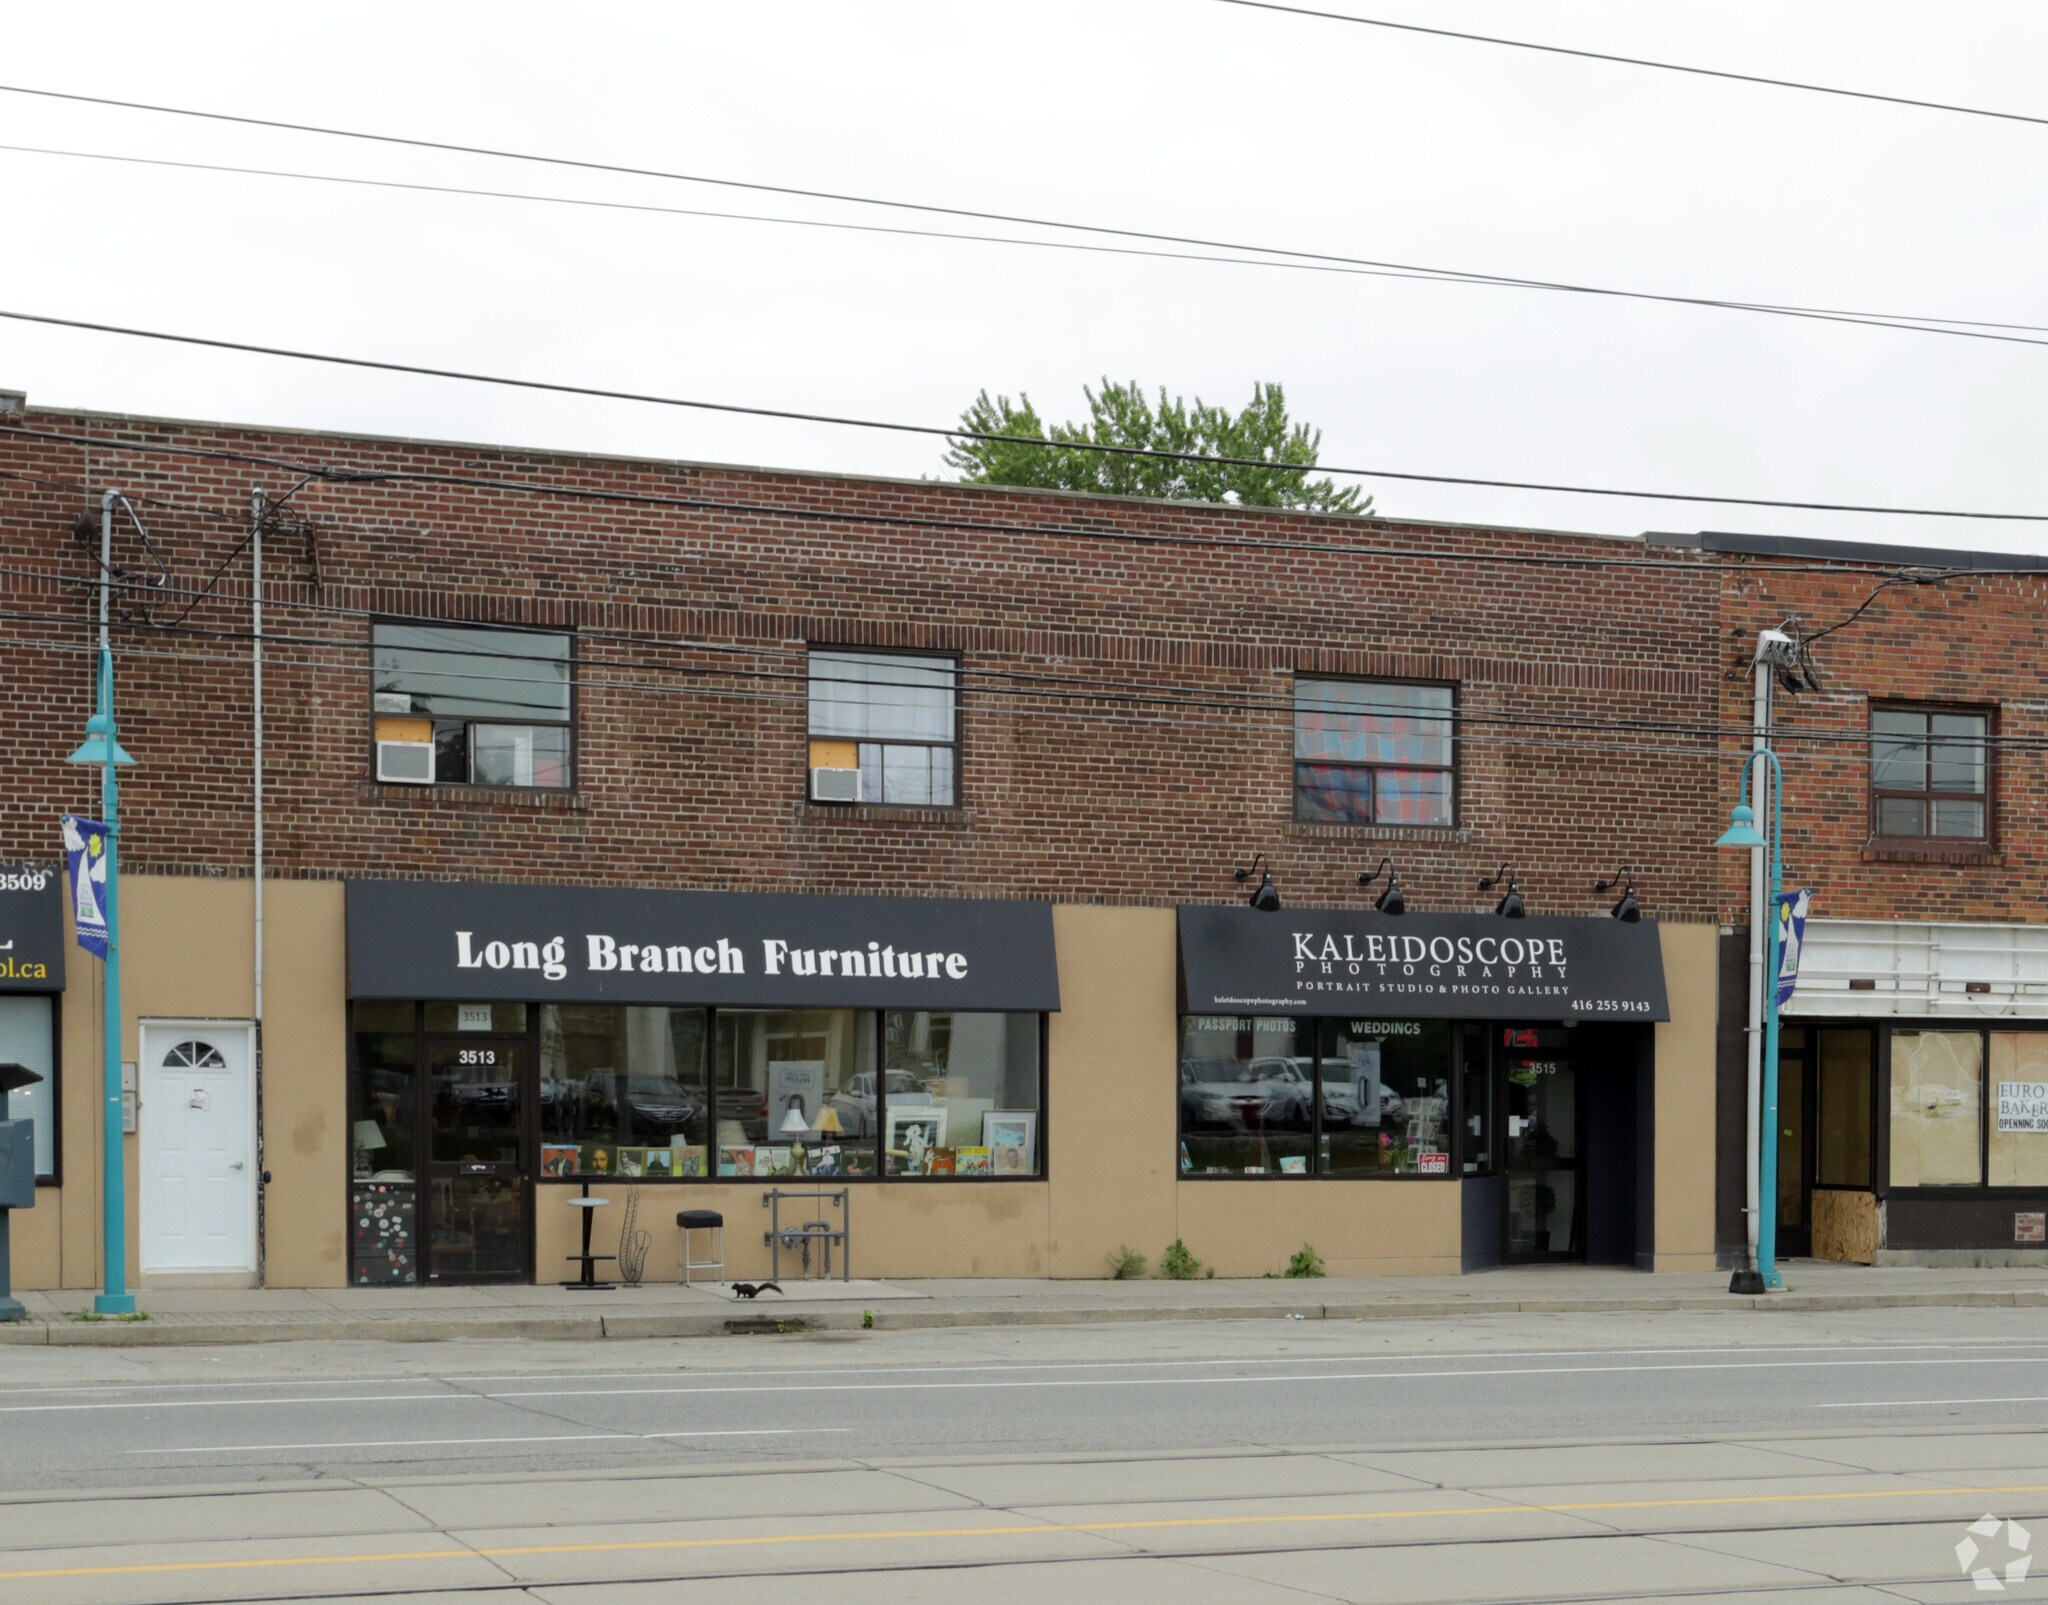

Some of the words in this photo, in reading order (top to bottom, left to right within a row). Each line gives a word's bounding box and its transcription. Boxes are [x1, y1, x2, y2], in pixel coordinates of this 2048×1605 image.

[1292, 932, 1567, 965] KALEIDOSCOPE
[456, 931, 567, 981] Long
[586, 934, 746, 975] Branch
[762, 939, 968, 980] Furniture
[1296, 961, 1567, 978] PHOTOGRAPHY
[1296, 981, 1370, 992] PORTRAIT
[1379, 983, 1434, 993] STUDIO
[1439, 985, 1447, 993] &
[1452, 984, 1500, 994] PHOTO
[1507, 986, 1569, 995] GALLERY
[1214, 996, 1307, 1006] kaleidoscopephotography.com
[1571, 1000, 1593, 1010] 416
[1596, 1000, 1618, 1011] 255
[1621, 1001, 1650, 1012] 9143
[463, 1012, 488, 1022] 3513
[1198, 1019, 1252, 1032] PASSPORT
[1256, 1020, 1296, 1033] PHOTOS
[1351, 1021, 1421, 1035] WEDDINGS
[459, 1050, 496, 1065] 3513
[1529, 1063, 1556, 1074] 3515
[2000, 1084, 2045, 1099] EURO
[1999, 1119, 2034, 1129] OPENNING
[1421, 1162, 1445, 1173] CLOSED
